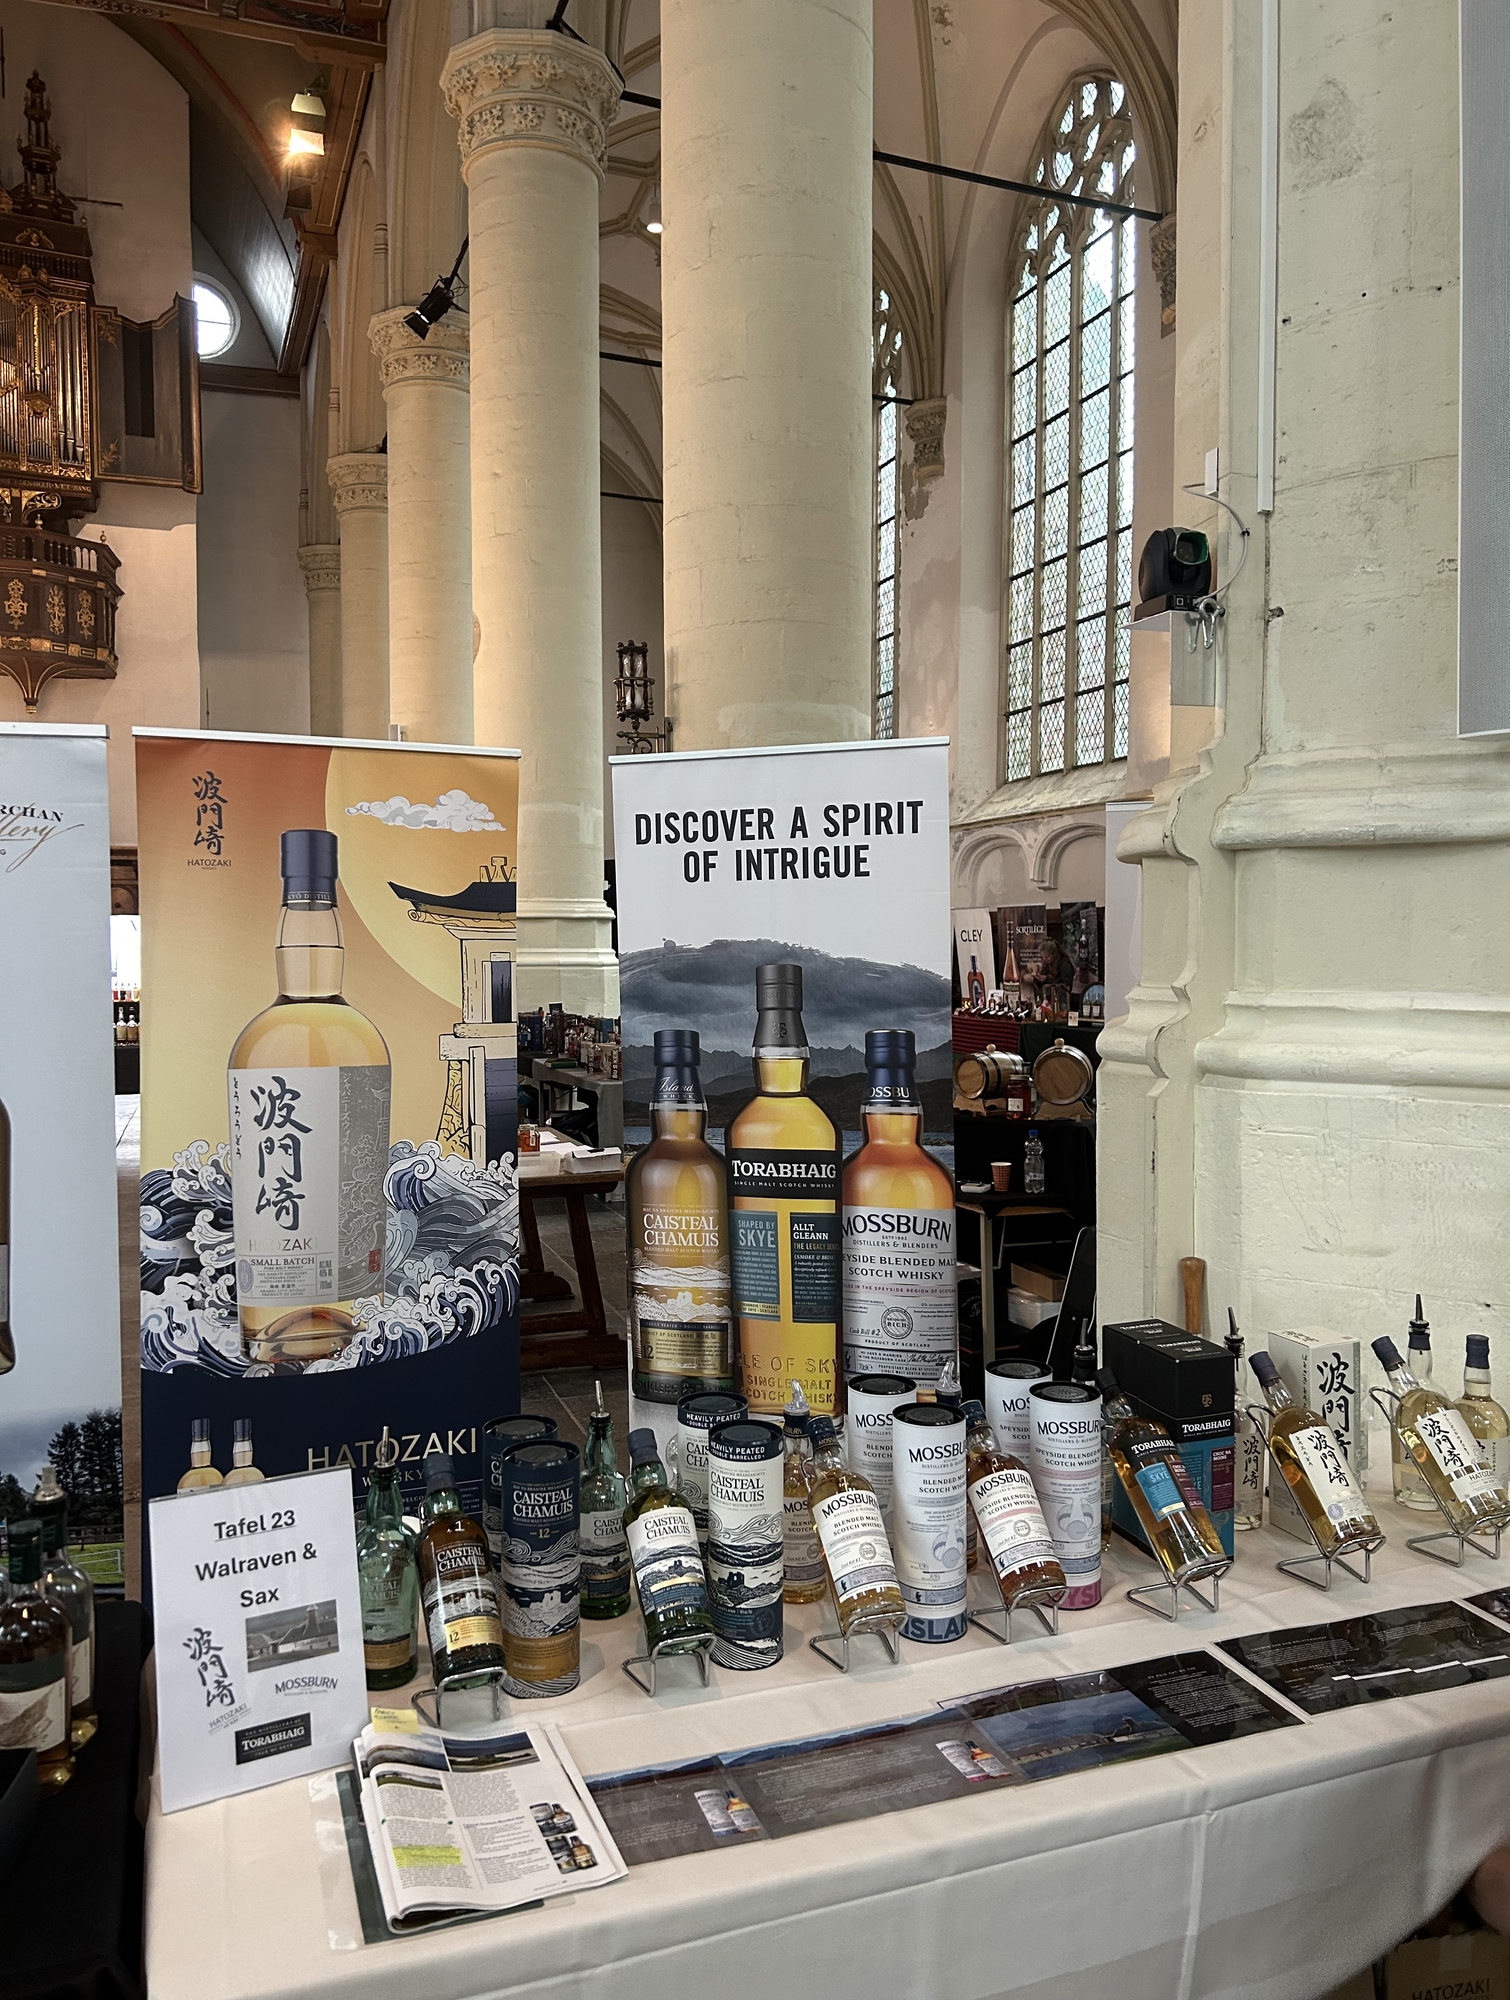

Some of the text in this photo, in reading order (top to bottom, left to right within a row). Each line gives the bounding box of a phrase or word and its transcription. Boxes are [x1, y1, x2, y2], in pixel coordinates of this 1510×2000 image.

[635, 801, 924, 845] DISCOVER A SPIRIT
[187, 858, 232, 868] HATOZAKI
[683, 844, 871, 883] OF INTRIGUE
[960, 929, 983, 942] CLEY
[659, 1076, 695, 1092] Island
[250, 1075, 313, 1231] 波門崎
[731, 1160, 837, 1179] TORABHAIG
[643, 1213, 719, 1230] CAISTEAL
[738, 1219, 776, 1229] SHAPED BY
[793, 1223, 815, 1231] ALLT
[842, 1213, 952, 1243] MOSSBURN
[643, 1230, 719, 1247] CHAMUIS
[738, 1229, 776, 1248] SKYE
[793, 1231, 829, 1240] GLEANN
[852, 1239, 890, 1247] DISTILLERS
[902, 1241, 939, 1249] BLENDERS
[251, 1257, 315, 1266] SMALL BATCH
[879, 1254, 935, 1267] BLENDED
[848, 1267, 945, 1280] SCOTCH WHISKY
[643, 1345, 654, 1359] 12
[770, 1356, 795, 1373] OF
[686, 1412, 741, 1423] HEAVILY PEATED
[999, 1424, 1030, 1432] SPEYSID
[1037, 1420, 1100, 1435] MOSSBUR
[1181, 1419, 1231, 1434] TORABHAIG
[307, 1428, 477, 1472] HATOZAKI
[686, 1441, 709, 1454] CAIS
[710, 1442, 765, 1455] HEAVILY PEATED
[908, 1441, 966, 1463] MOSSBU
[1035, 1447, 1096, 1459] SPEYSIDE BLENDED
[686, 1454, 709, 1467] CHA
[1045, 1458, 1076, 1467] SCOTCH
[710, 1470, 764, 1490] CAISTEAL
[922, 1477, 957, 1485] BLENDED
[1150, 1470, 1170, 1483] SKYE
[710, 1483, 765, 1503] CHAMUIS
[919, 1486, 951, 1494] SCOTCH
[975, 1472, 1032, 1499] MOSSBURN
[513, 1487, 573, 1505] CAISTEAL
[1003, 1493, 1030, 1503] BLENDED
[513, 1500, 573, 1518] CHAMUIS
[821, 1493, 879, 1519] MOSSBURN
[987, 1503, 1012, 1516] SCOTCH
[213, 1509, 296, 1540] Tafel 23
[593, 1519, 623, 1528] CAIST
[644, 1514, 689, 1531] CAISTEAL
[834, 1516, 864, 1528] BLENDED
[538, 1528, 551, 1538] 12
[594, 1526, 623, 1536] CHAM
[646, 1525, 691, 1540] CHAMUIS
[833, 1524, 860, 1536] SCOTCH
[195, 1542, 318, 1581] Walraven &
[436, 1546, 485, 1562] CAISTEAL
[438, 1555, 486, 1572] CHAMUIS
[240, 1587, 280, 1608] Sax
[448, 1631, 460, 1644] 12
[275, 1675, 338, 1695] MOSSBURN
[209, 1702, 248, 1729] HATOZAKI
[241, 1726, 305, 1751] TORABHAIG
[1411, 1978, 1490, 2000] HATOZAKI
